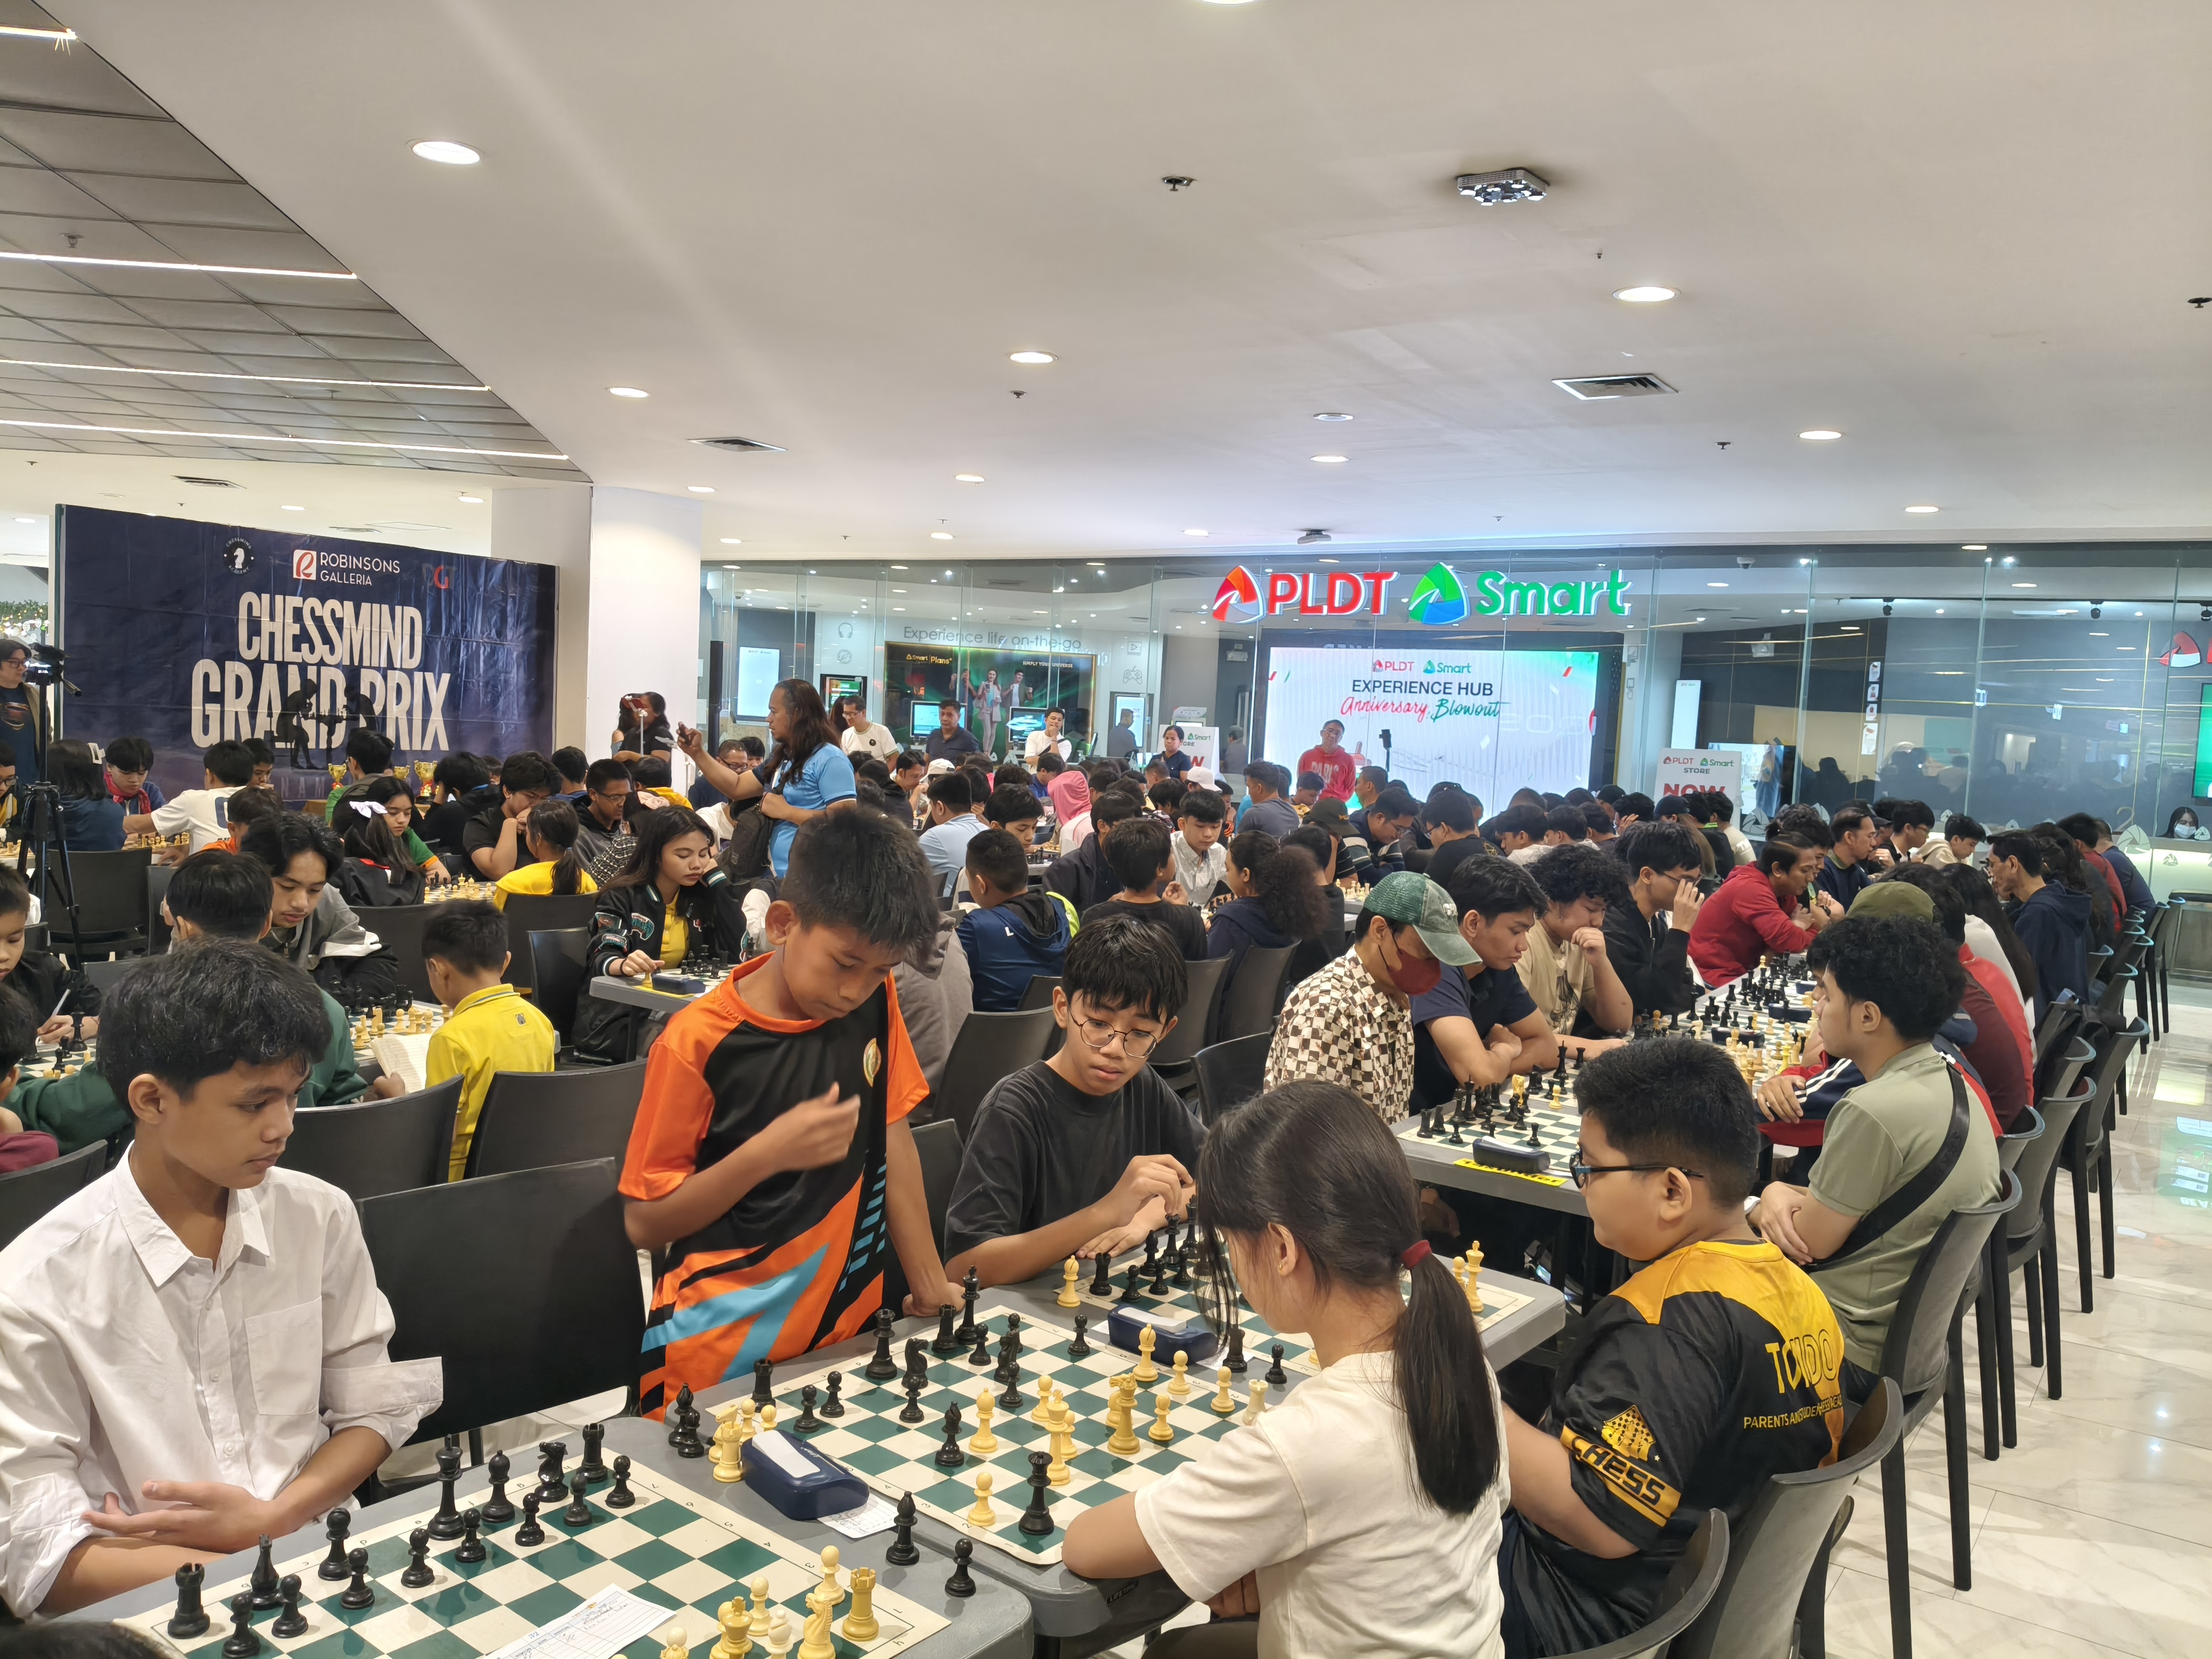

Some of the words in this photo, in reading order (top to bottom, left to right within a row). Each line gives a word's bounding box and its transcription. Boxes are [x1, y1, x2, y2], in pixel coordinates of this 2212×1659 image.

[320, 552, 400, 574] ROBINSONS
[320, 570, 372, 586] GALLERIA
[1268, 571, 1399, 616] PLDT
[1476, 569, 1631, 616] Smart
[238, 591, 423, 669] CHESSMIND
[903, 626, 983, 643] Experience
[988, 631, 1007, 644] life
[1011, 635, 1082, 651] on-the-go
[1385, 661, 1414, 672] PLDT
[1437, 663, 1472, 673] Smart
[1352, 679, 1453, 694] EXPERIENCE
[1458, 682, 1493, 696] HUB
[191, 659, 347, 749] GRAND
[360, 668, 451, 751] PRIX
[1340, 696, 1429, 723] Anniversary
[1430, 698, 1511, 723] Blowout
[1709, 759, 1734, 767] Smart
[1744, 1413, 1789, 1428] PARENTS
